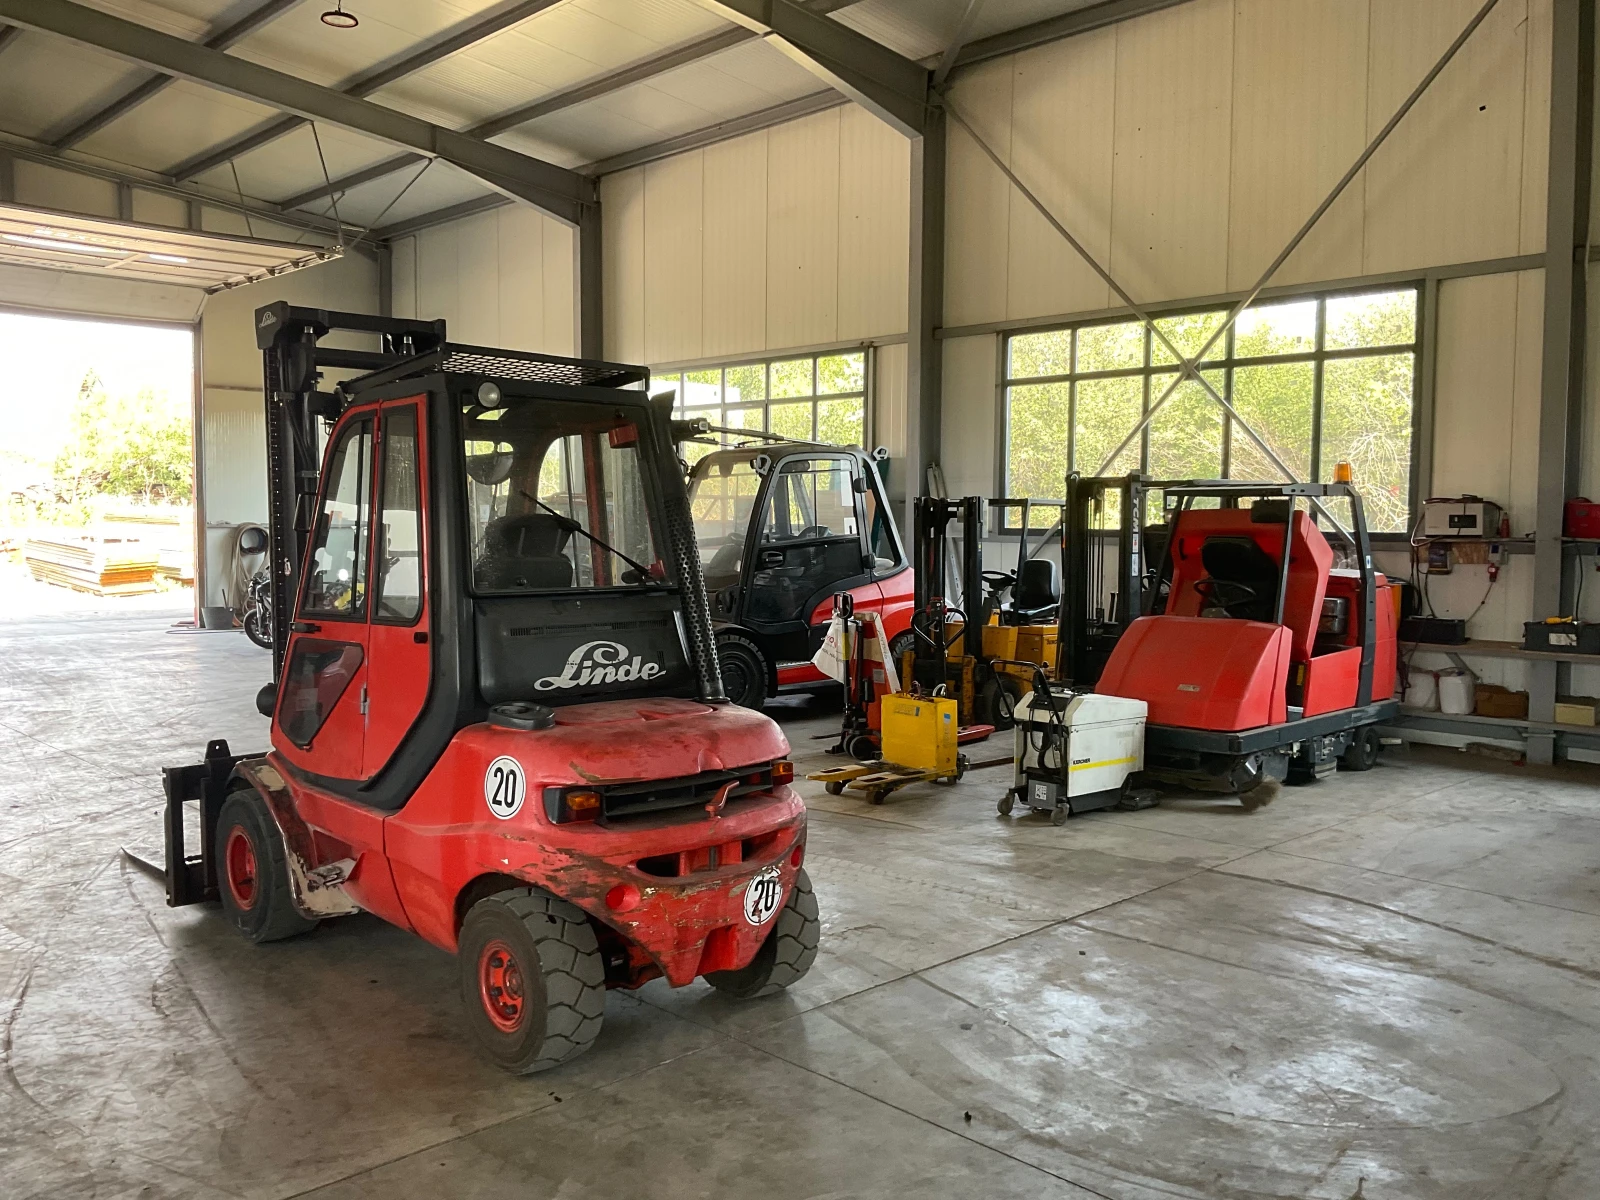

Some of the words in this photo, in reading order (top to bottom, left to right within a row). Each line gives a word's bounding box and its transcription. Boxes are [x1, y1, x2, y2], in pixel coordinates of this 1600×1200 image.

[259, 311, 277, 328] Linde
[533, 640, 667, 691] Linde
[492, 766, 517, 808] 20
[752, 879, 776, 916] 20
